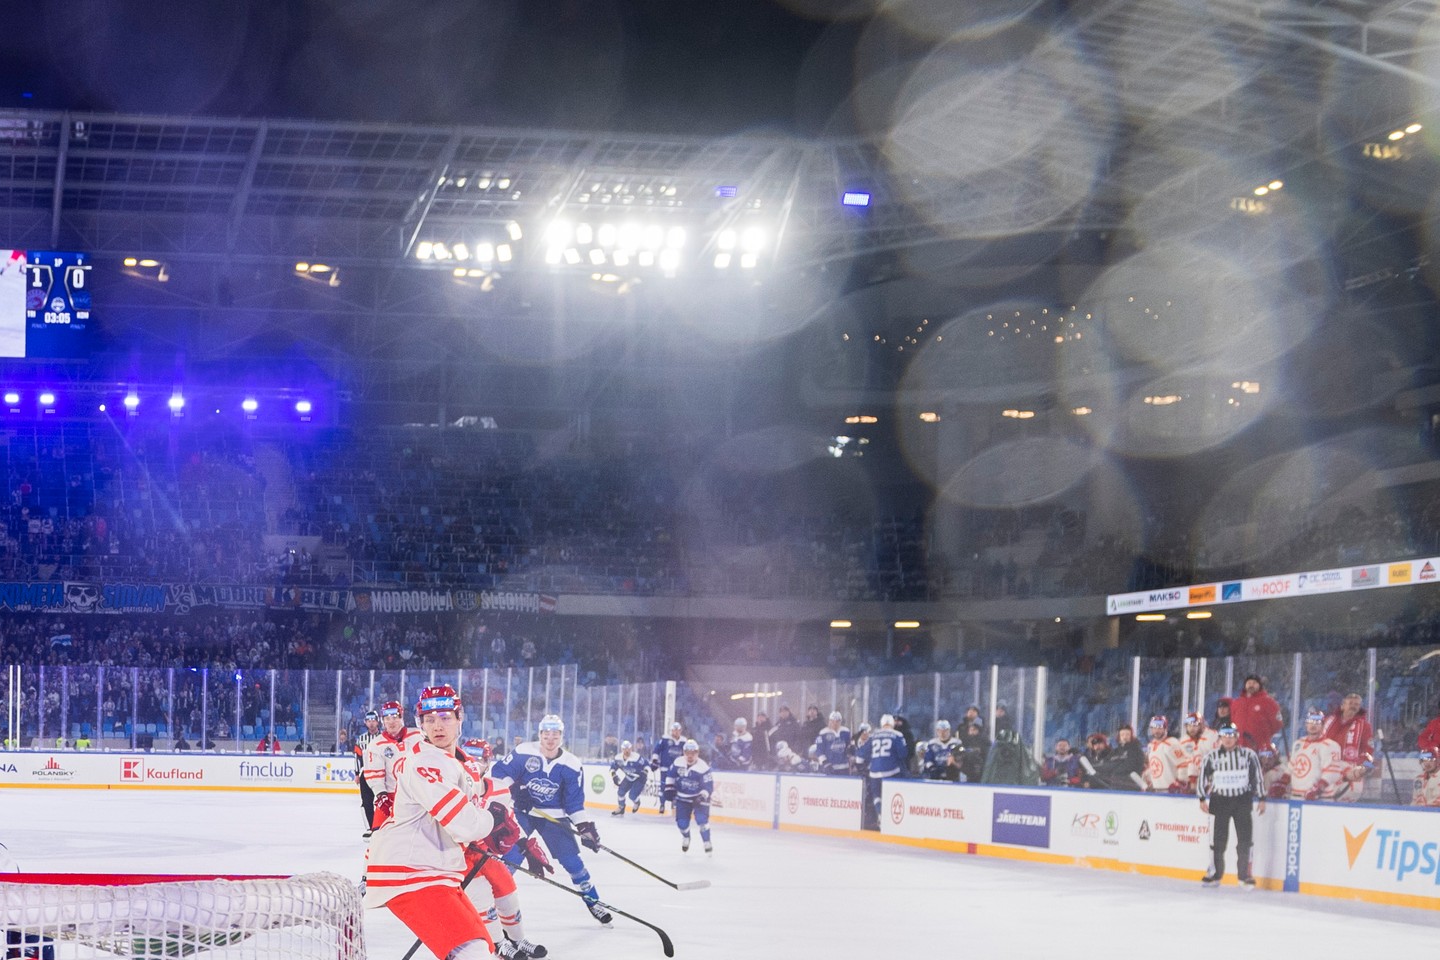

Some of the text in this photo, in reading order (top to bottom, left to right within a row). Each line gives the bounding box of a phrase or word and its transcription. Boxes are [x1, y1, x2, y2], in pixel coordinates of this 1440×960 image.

[32, 268, 42, 287] 1
[73, 269, 84, 288] 0
[44, 312, 71, 324] 03:05
[1149, 591, 1181, 602] MAKSO
[871, 739, 892, 758] 22
[147, 768, 203, 780] Kaufland
[239, 761, 294, 777] finclub
[417, 767, 443, 783] 97
[909, 806, 965, 820] MORAVIA STEEL
[996, 810, 1046, 827] JÁGRTEAM
[1288, 808, 1301, 877] Reebok
